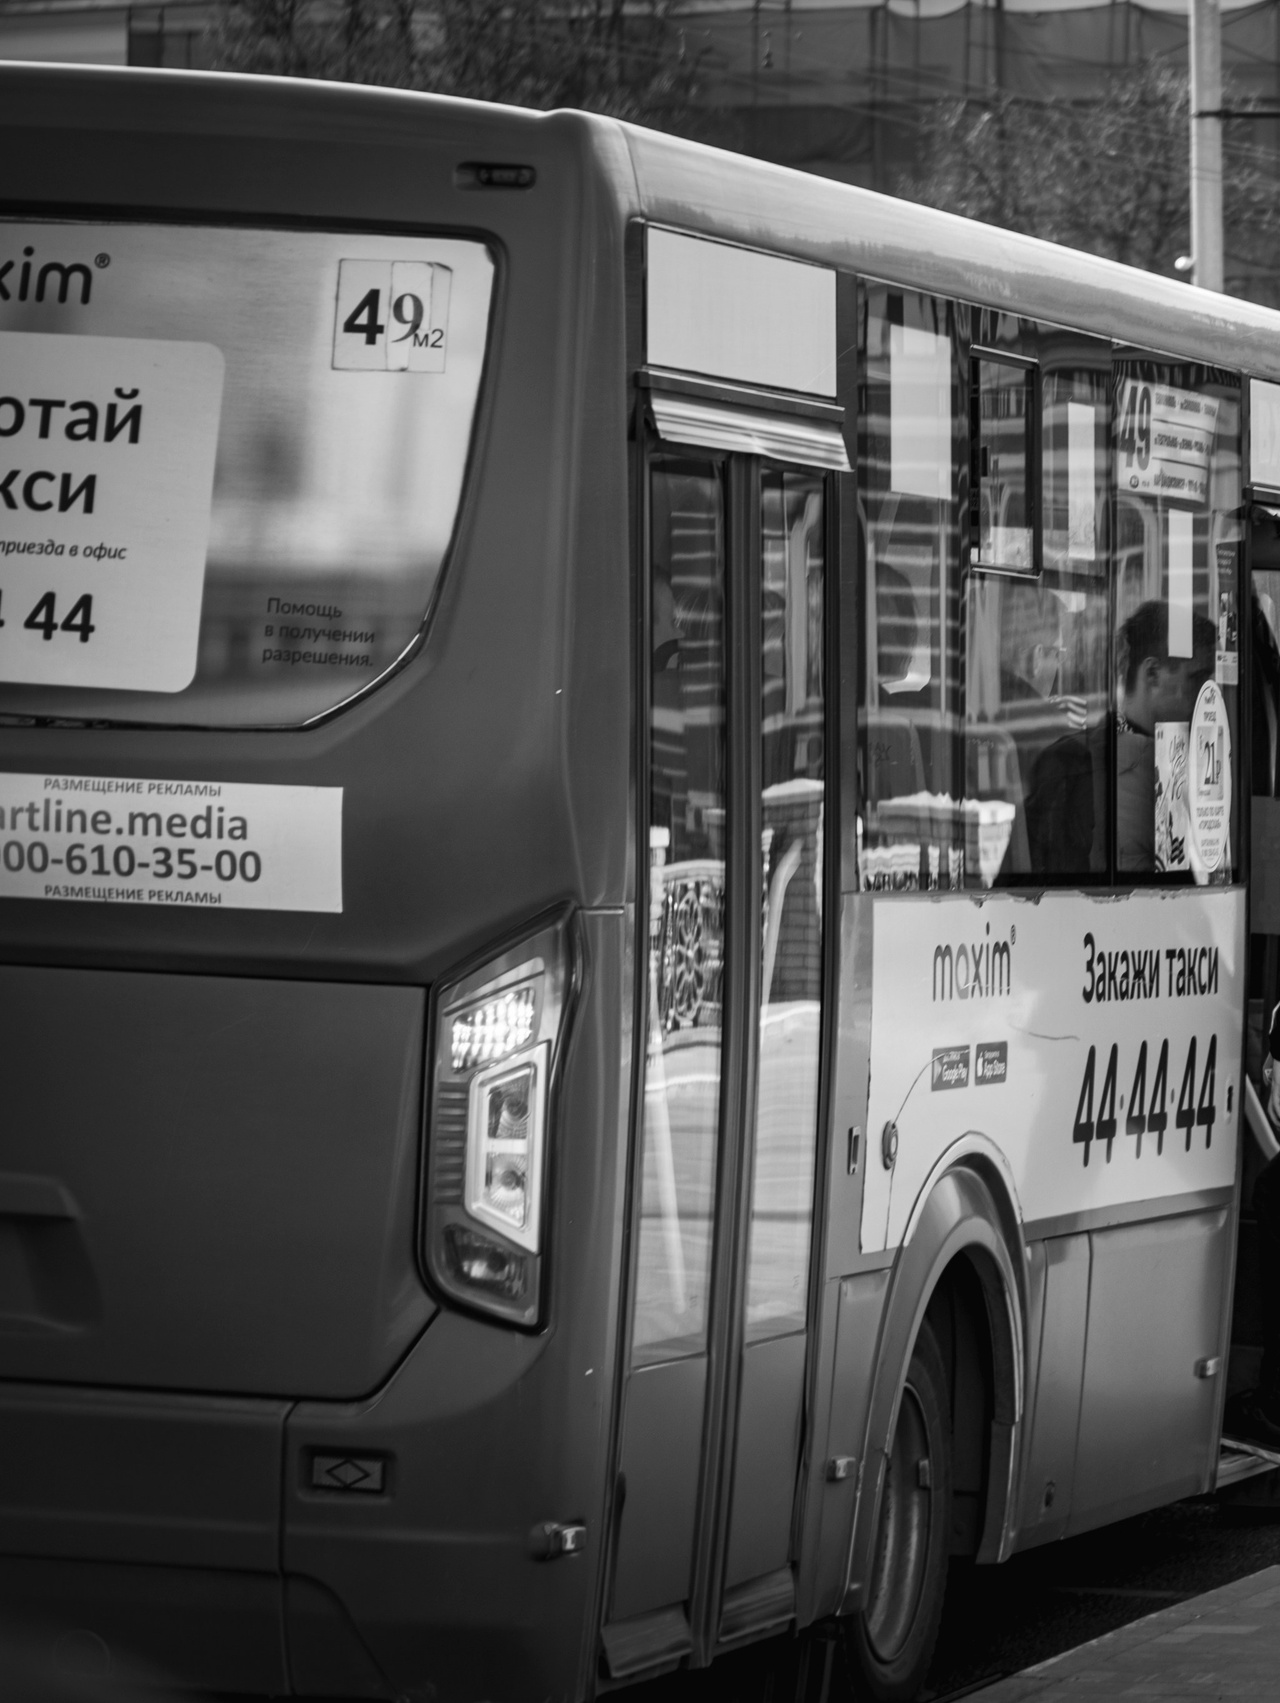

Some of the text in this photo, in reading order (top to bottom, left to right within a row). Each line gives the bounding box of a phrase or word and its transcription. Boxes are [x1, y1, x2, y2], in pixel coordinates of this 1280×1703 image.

[343, 288, 424, 345] 49
[1119, 384, 1150, 471] 49
[69, 545, 78, 557] в
[83, 542, 127, 561] офис
[24, 591, 95, 643] 44
[267, 596, 343, 620] Помощь
[264, 624, 375, 643] в получении
[262, 648, 373, 667] разрешения.
[44, 778, 222, 797] РАЗМЕЩЕНИЕ РЕКЛАМЫ
[44, 885, 222, 904] РАЗМЕЩЕНИЕ РЕКЛАМЫ
[1082, 932, 1218, 1004] Закажи такси
